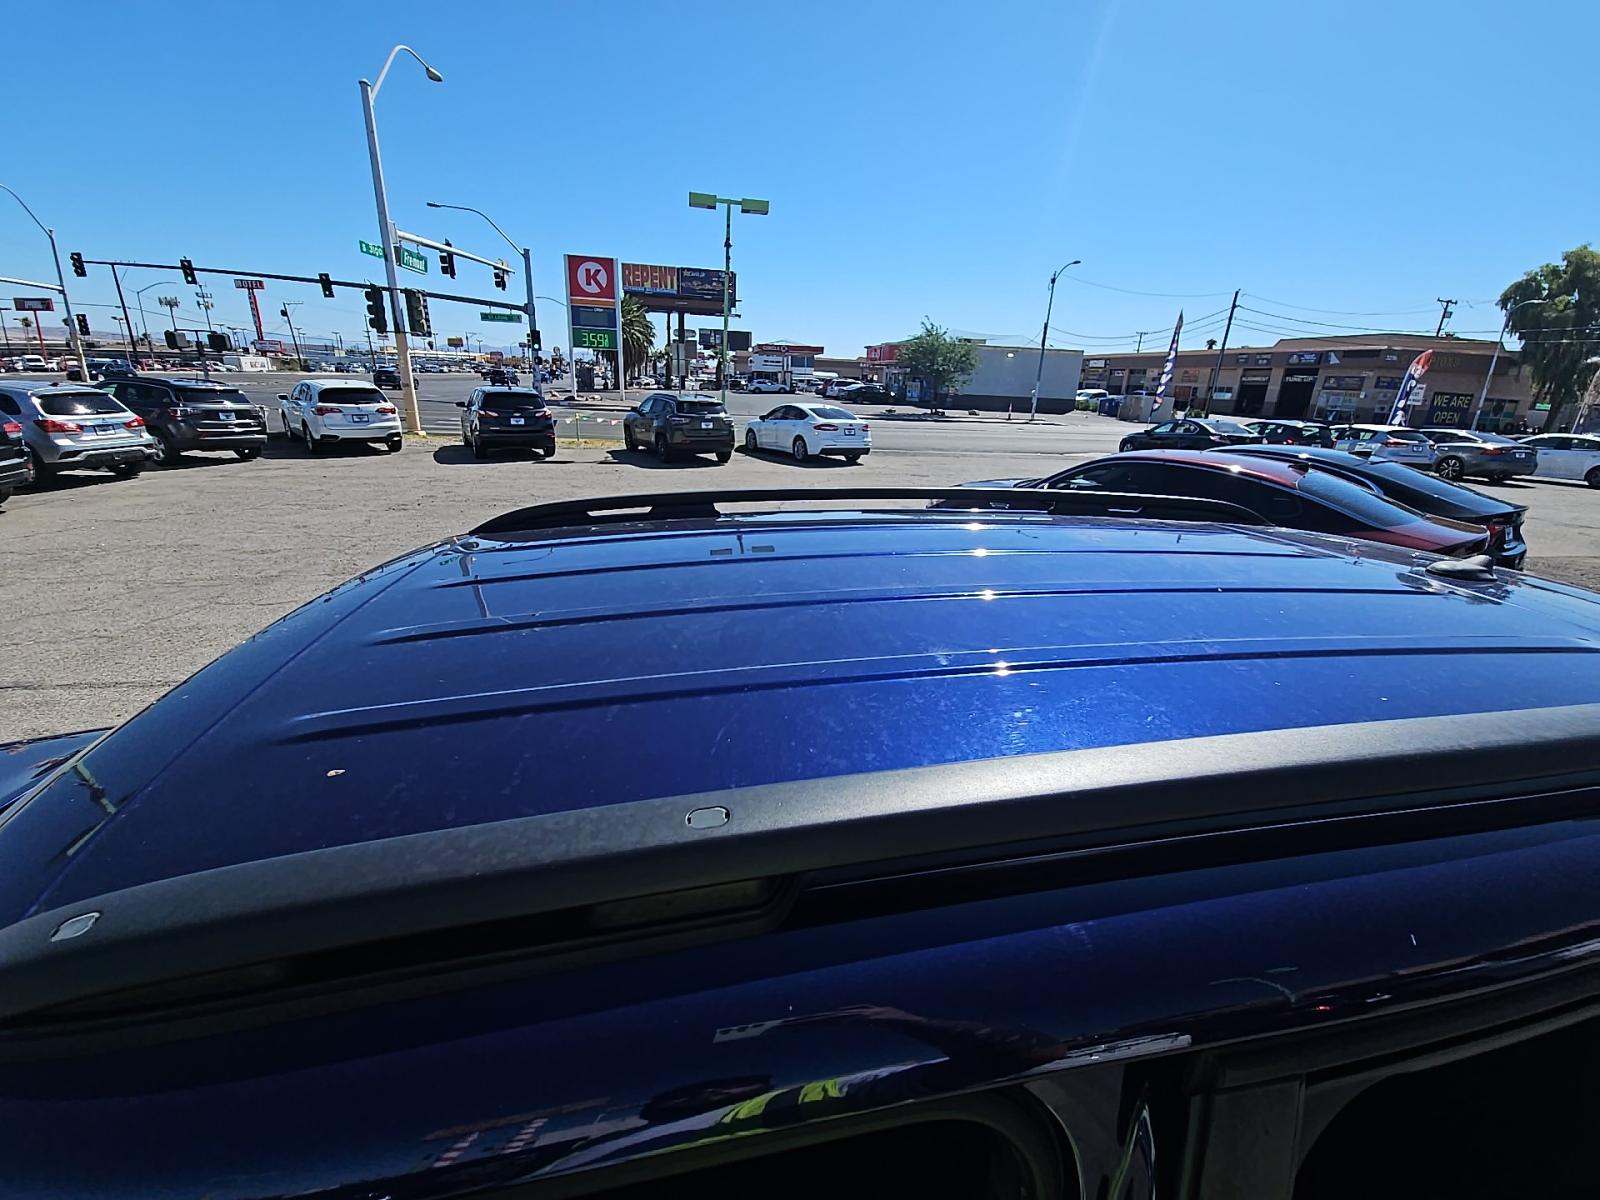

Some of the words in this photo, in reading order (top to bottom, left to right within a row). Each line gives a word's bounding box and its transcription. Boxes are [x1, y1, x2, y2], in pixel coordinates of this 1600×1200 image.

[585, 267, 605, 291] K
[623, 264, 677, 289] REPENT
[235, 280, 264, 289] MOTEL
[1433, 395, 1449, 407] WE
[1450, 396, 1471, 408] ARE
[1433, 412, 1460, 424] OPEN
